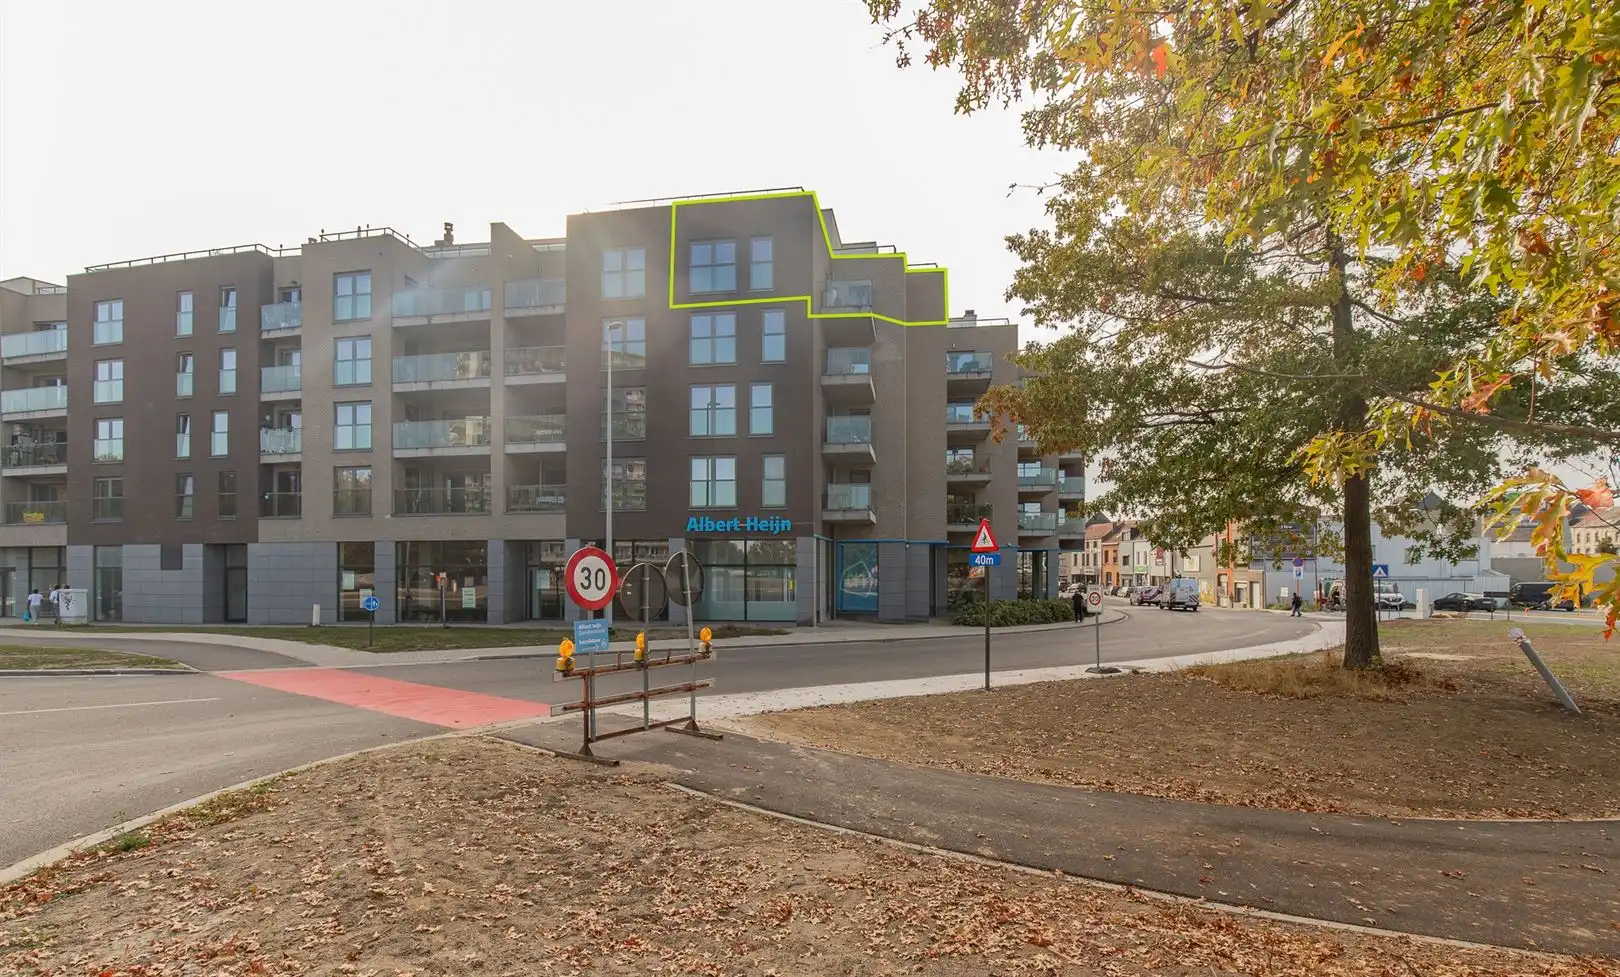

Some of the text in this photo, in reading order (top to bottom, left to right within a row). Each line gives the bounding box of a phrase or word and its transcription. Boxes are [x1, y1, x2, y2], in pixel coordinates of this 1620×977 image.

[687, 516, 792, 534] Albert Heijn
[975, 555, 994, 565] 40m
[580, 566, 606, 591] 30
